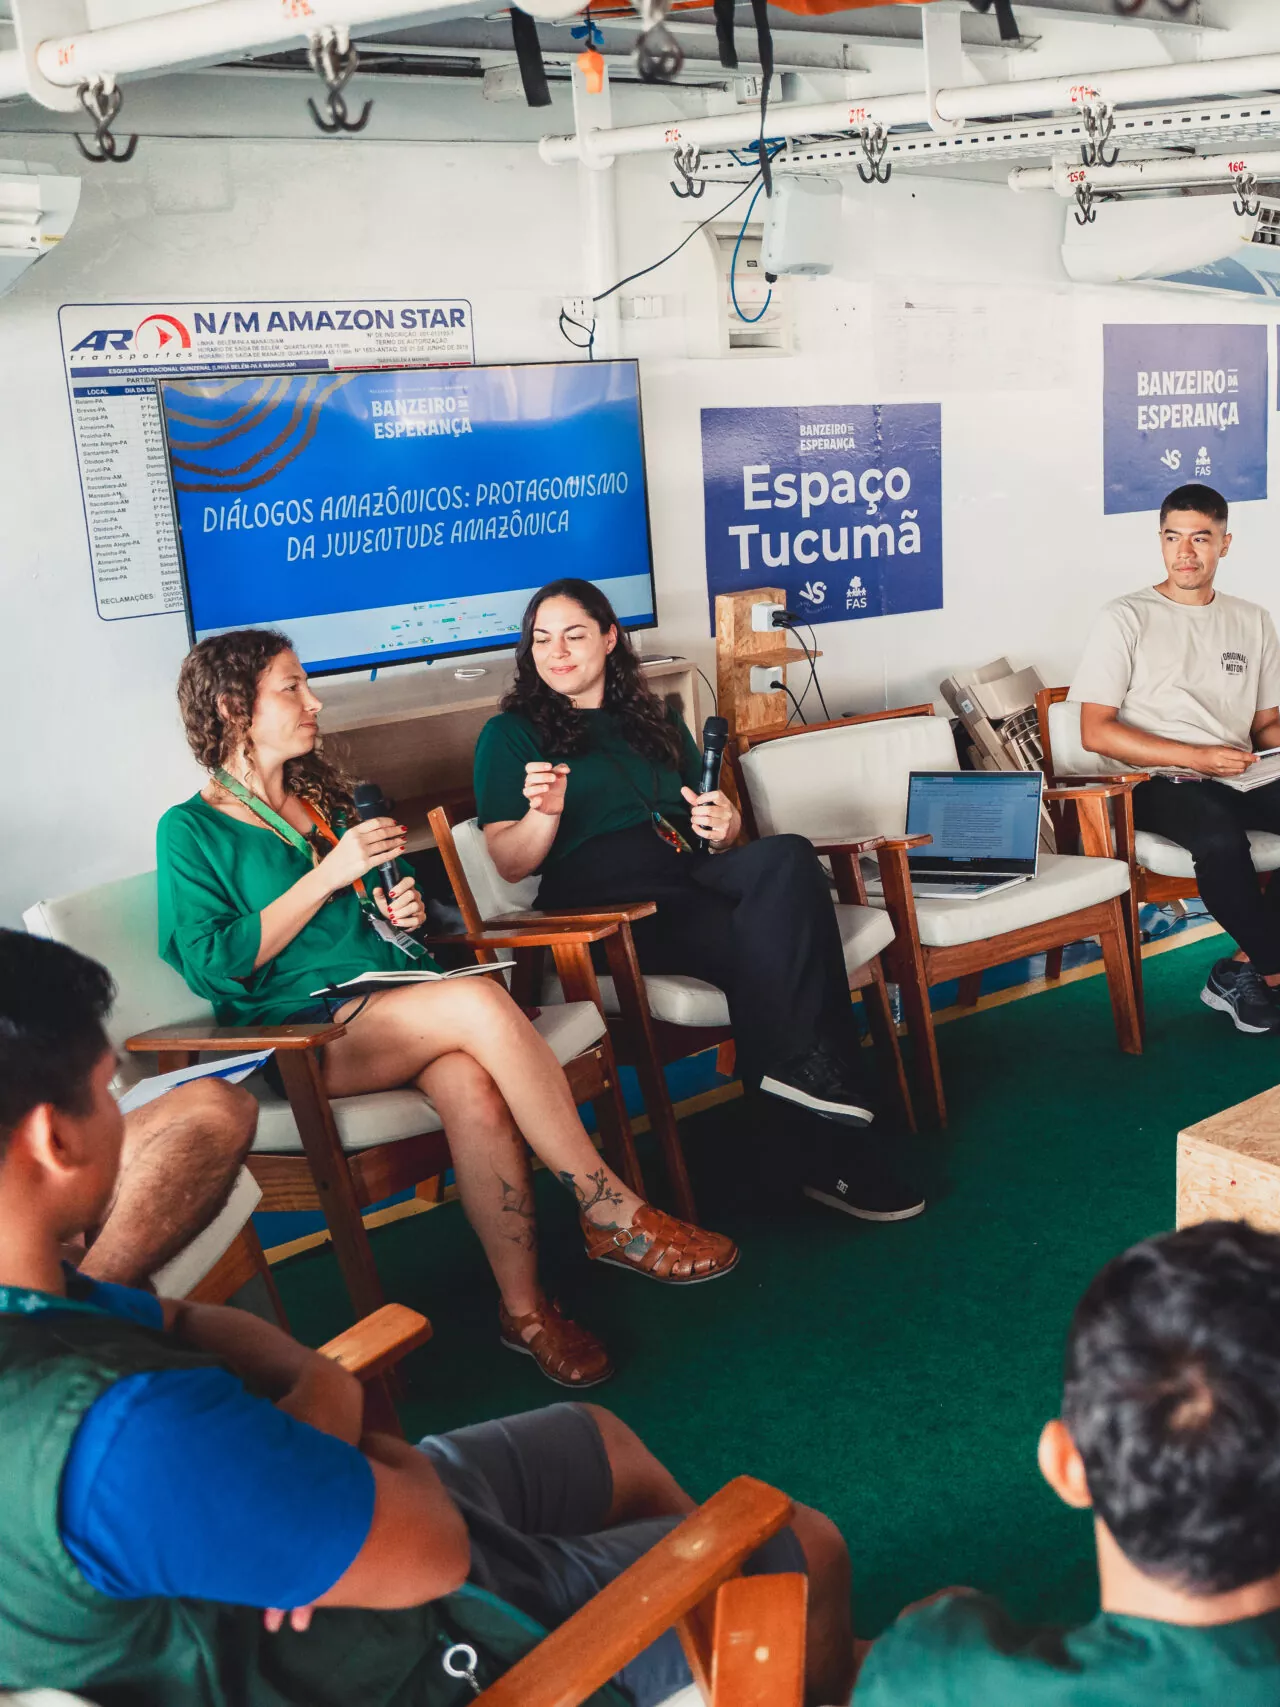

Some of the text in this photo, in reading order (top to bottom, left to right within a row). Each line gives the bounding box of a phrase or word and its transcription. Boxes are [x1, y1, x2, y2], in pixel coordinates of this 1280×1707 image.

[1228, 162, 1244, 173] 160
[193, 308, 466, 334] N/M AMAZON STAR
[71, 329, 134, 352] AR
[70, 352, 193, 361] transportes
[108, 366, 136, 375] ESQUEMA
[137, 365, 179, 374] OPERACIONAL
[1137, 369, 1239, 397] BANZEIRO DA
[371, 396, 456, 417] BANZEIRO
[1137, 401, 1240, 431] ESPERANÇA
[373, 417, 473, 439] ESPERANÇA
[799, 423, 847, 437] BANZEIRO
[800, 437, 855, 452] ESPERANÇA
[1195, 466, 1212, 477] FAS
[743, 464, 911, 518] Espaço
[203, 497, 314, 533] DIÁLOGOS
[320, 485, 470, 522] AMAZÔNICOS:
[476, 471, 629, 507] PROTAGONISMO
[287, 509, 570, 562] DA JUVENTUDE AMAZÔNICA
[728, 509, 921, 570] Tucumã
[846, 597, 867, 610] FAS
[1222, 651, 1246, 663] ORIGINAL
